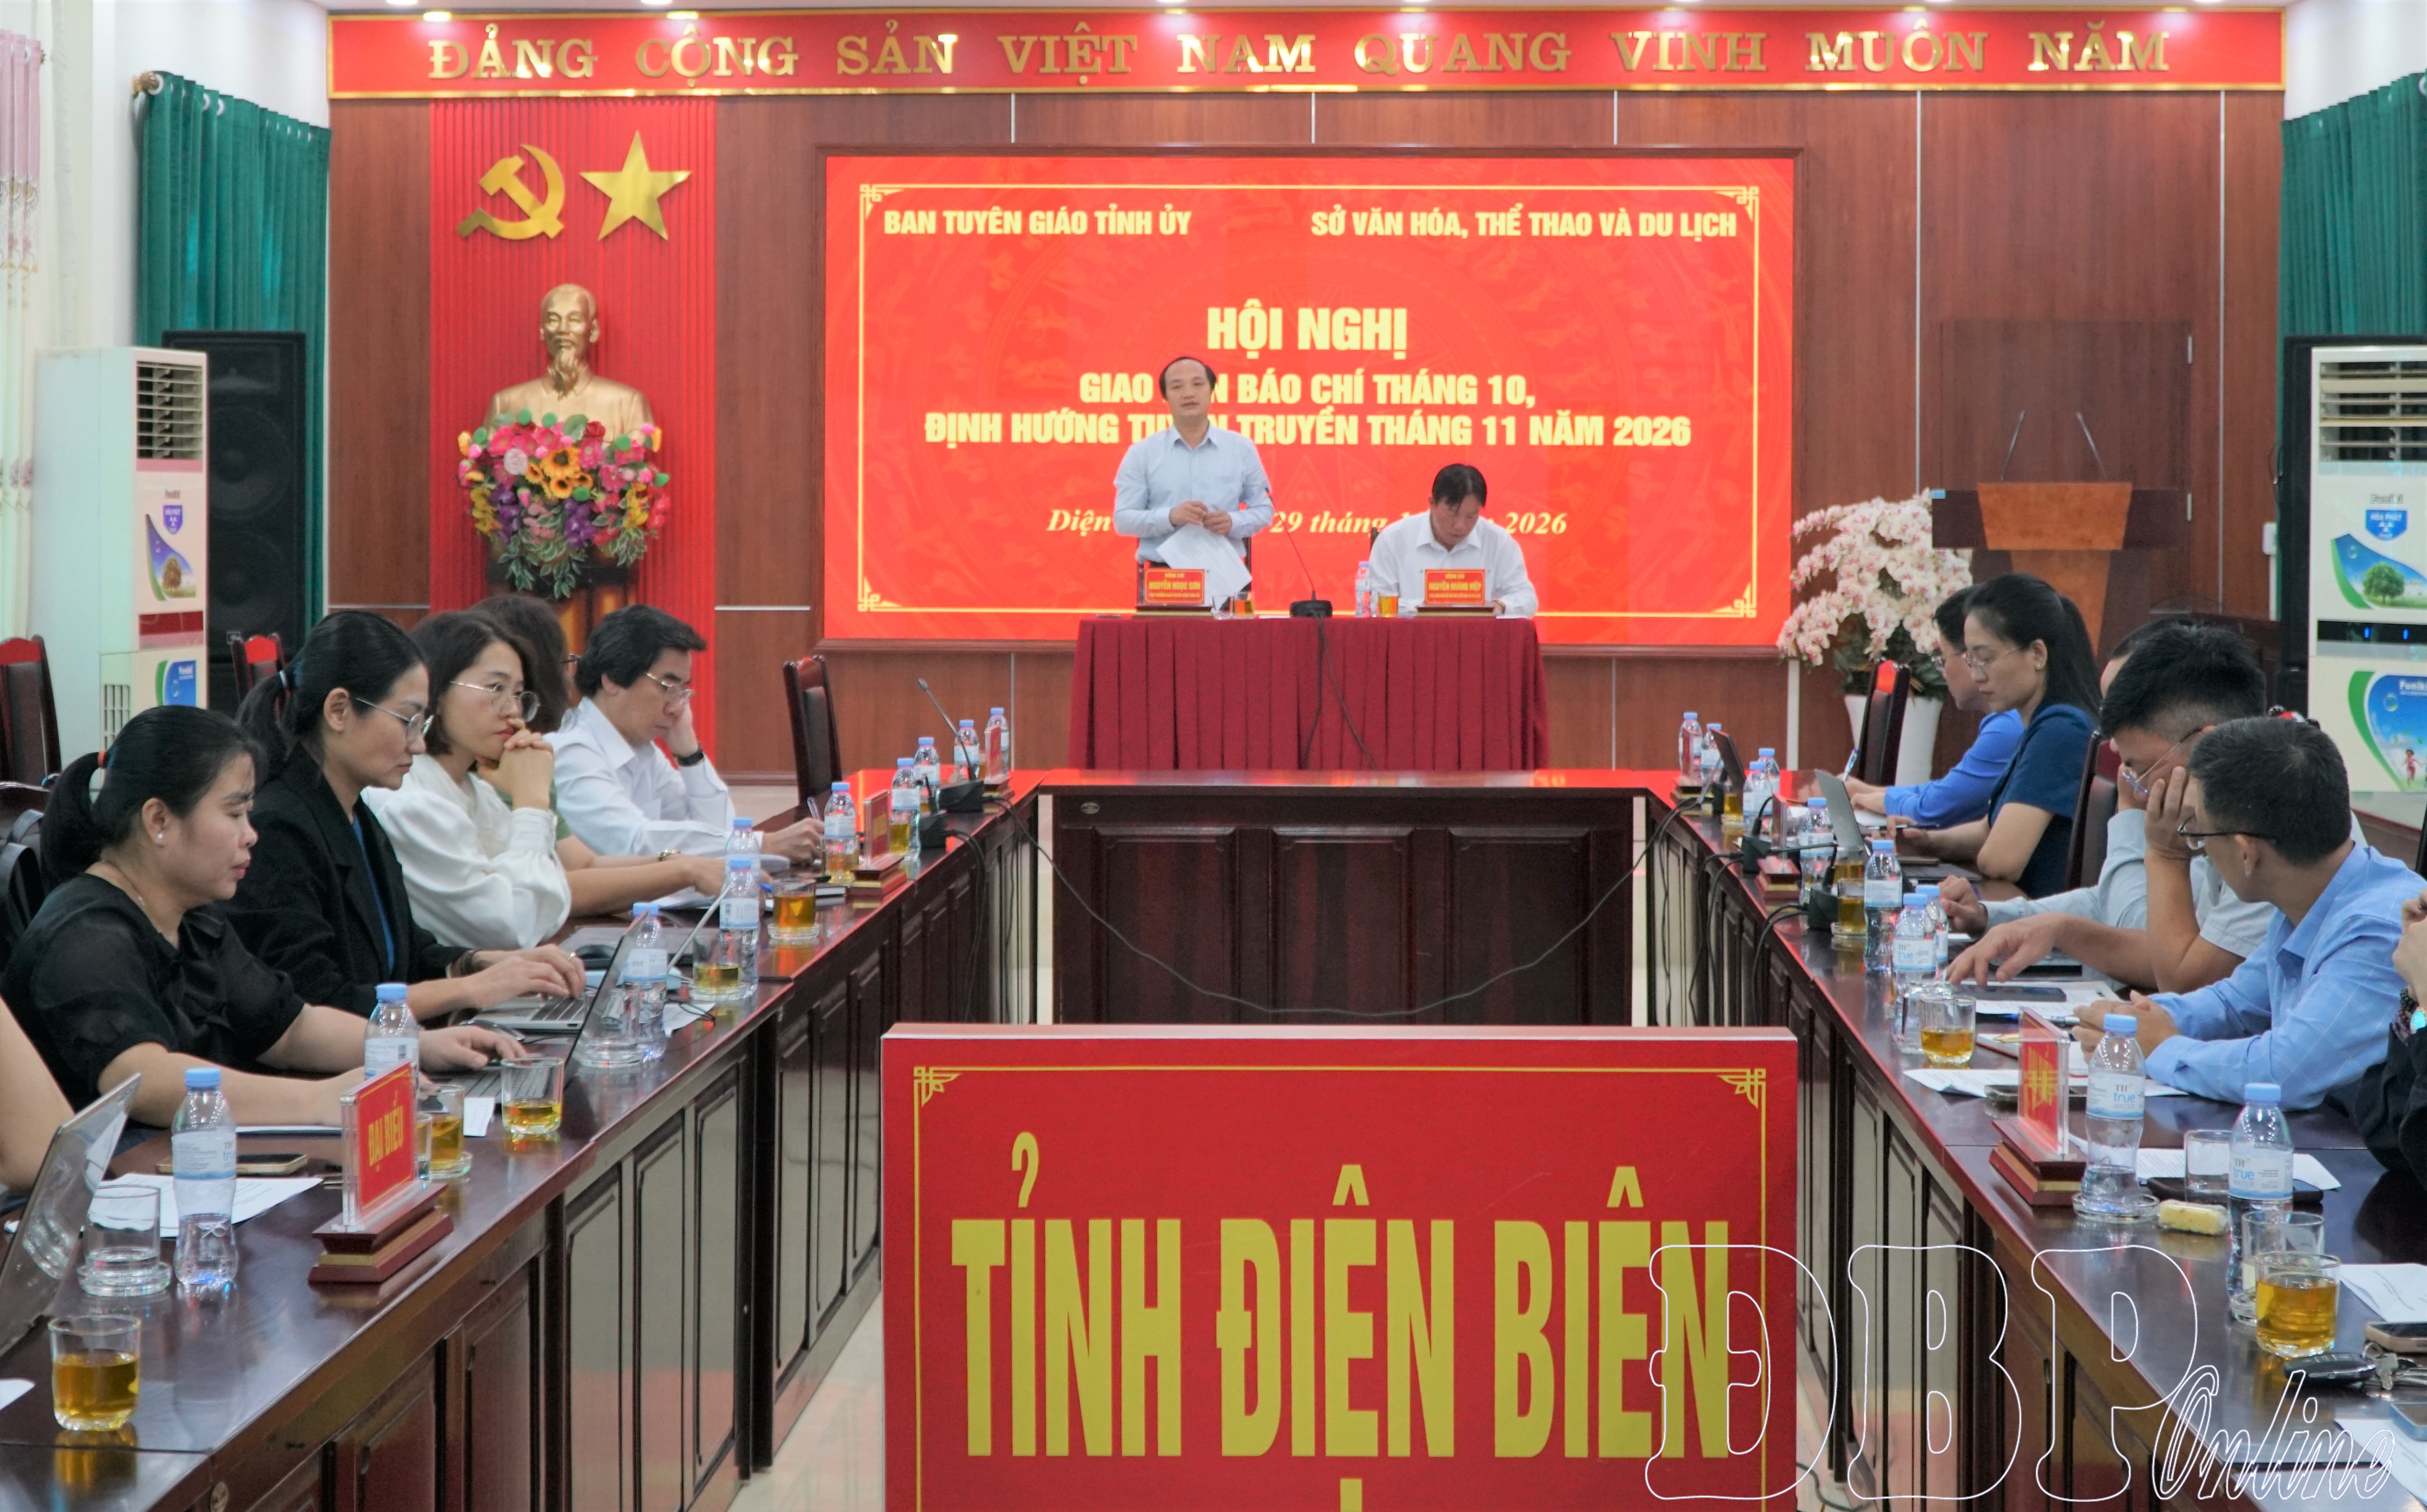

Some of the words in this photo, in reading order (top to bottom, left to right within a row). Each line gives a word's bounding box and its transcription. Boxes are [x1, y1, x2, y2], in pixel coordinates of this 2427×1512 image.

[429, 23, 597, 79] ĐẢNG
[636, 23, 799, 87] CỘNG
[837, 19, 959, 75] SẢN
[997, 22, 1138, 85] VIỆT
[1176, 34, 1316, 73] NAM
[1354, 31, 1571, 76] QUANG
[1611, 31, 1766, 71] VINH
[1805, 19, 1988, 72] MUÔN
[2028, 20, 2169, 72] NĂM
[884, 210, 936, 234] BAN
[943, 206, 1021, 234] TUYÊN
[1029, 207, 1087, 235] GIÁO
[1094, 204, 1152, 235] TỈNH
[1160, 204, 1191, 235] ỦY
[1311, 204, 1346, 236] SỞ
[1352, 207, 1403, 236] VĂN
[1410, 208, 1468, 238] HÓA,
[1475, 203, 1523, 236] THỂ
[1529, 212, 1592, 236] THAO
[1599, 208, 1632, 236] VÀ
[1639, 212, 1673, 236] DU
[1681, 213, 1736, 242] LỊCH
[1208, 299, 1283, 359] HỘI
[1298, 308, 1407, 359] NGHỊ
[1079, 373, 1153, 403] GIAO
[1237, 368, 1301, 404] BÁO
[1311, 369, 1364, 405] CHÍ
[1372, 369, 1478, 405] THÁNG
[1488, 375, 1535, 408] 10,
[925, 413, 1002, 449] ĐỊNH
[1011, 407, 1119, 444] HƯỚNG
[1237, 406, 1359, 445] TRUYỀN
[1367, 409, 1472, 445] THÁNG
[1482, 416, 1516, 445] 11
[1529, 410, 1604, 446] NĂM
[1614, 416, 1691, 446] 2026
[1270, 511, 1303, 533] 29
[1505, 512, 1568, 535] 2026
[2113, 1092, 2135, 1103] true
[2234, 1167, 2255, 1181] true
[952, 1132, 1181, 1456] TỈNH
[1216, 1164, 1454, 1512] ĐIỆN
[1494, 1166, 1728, 1458] BIÊN
